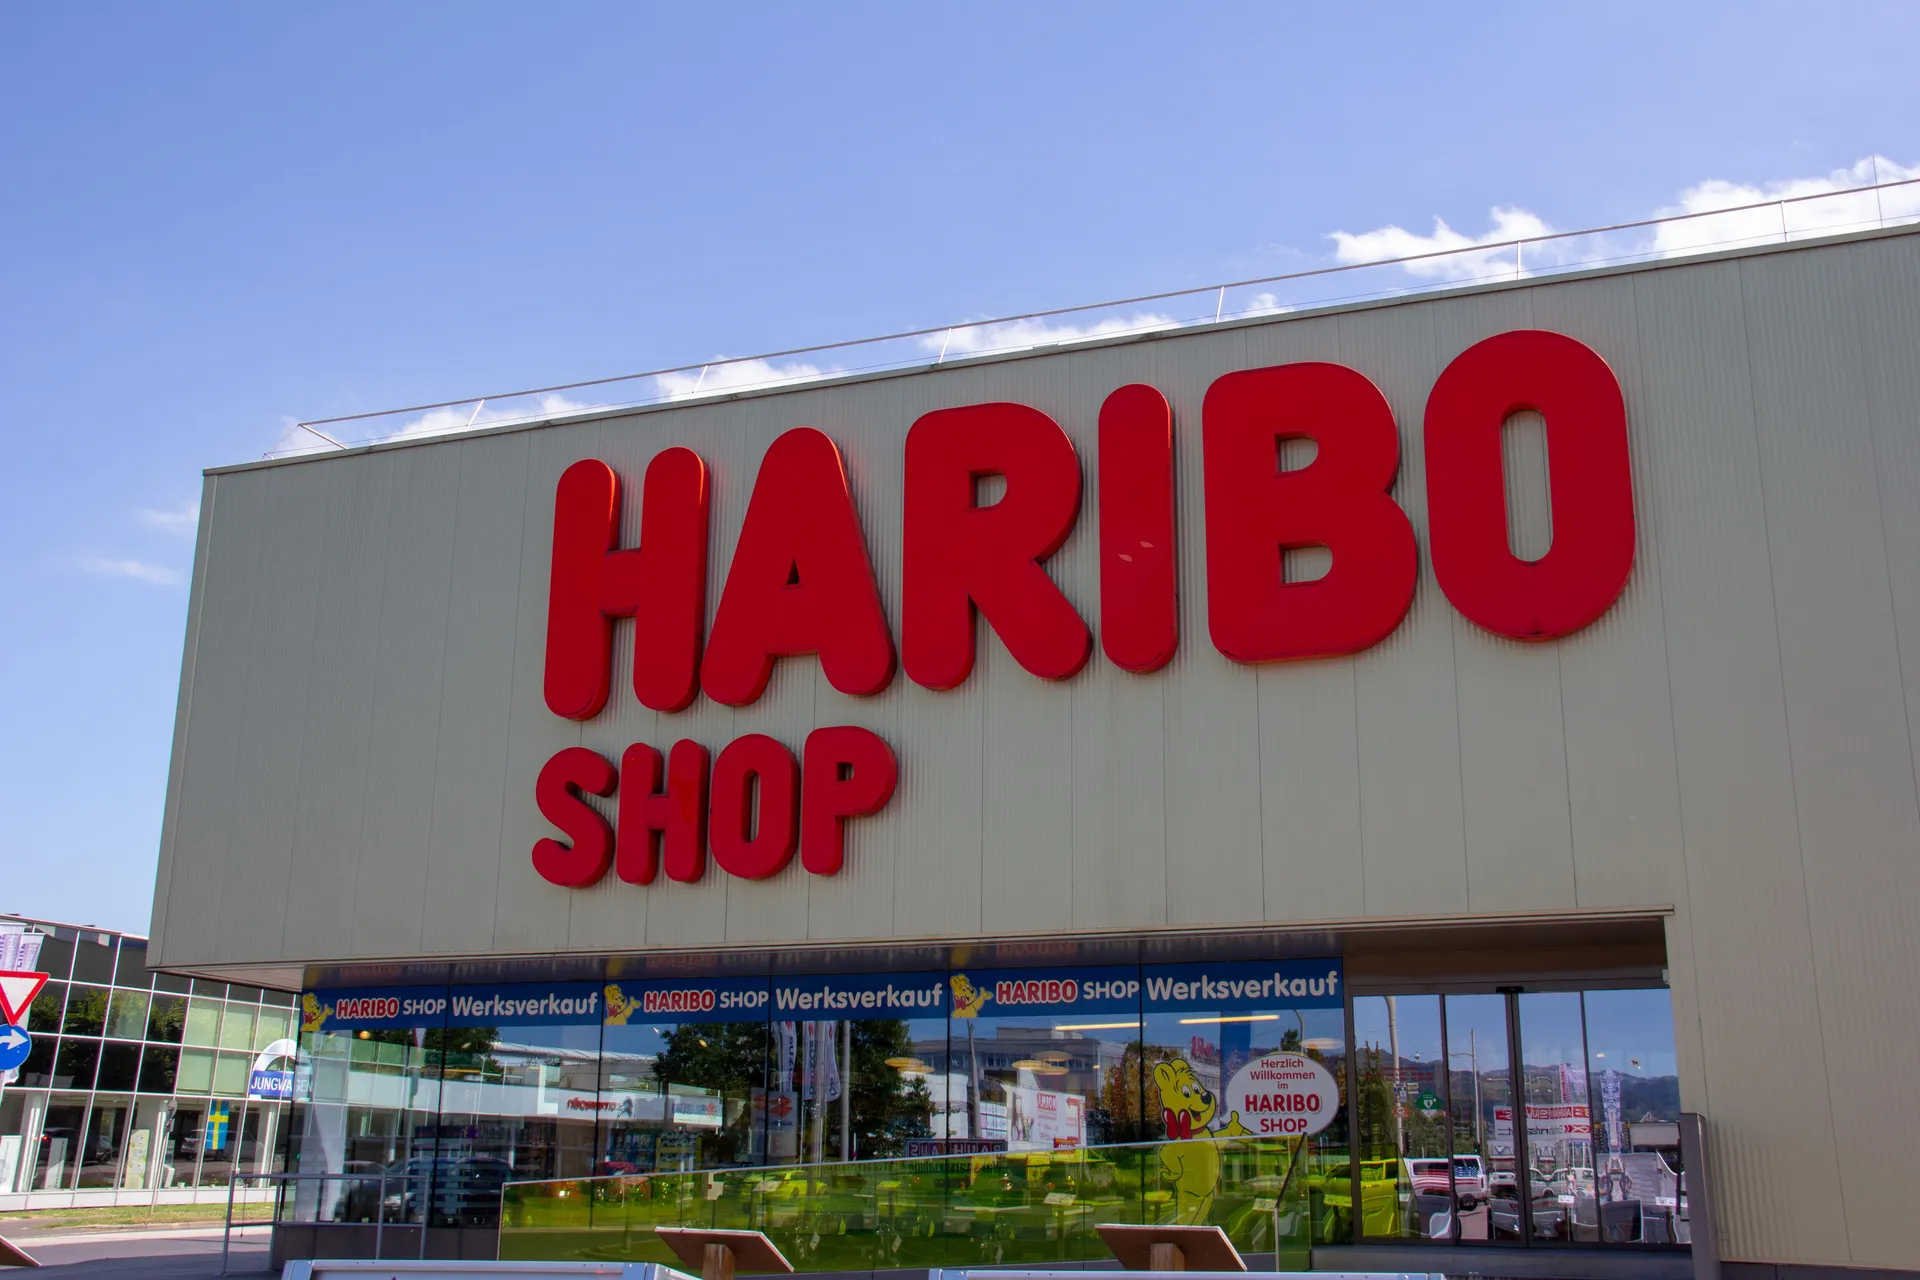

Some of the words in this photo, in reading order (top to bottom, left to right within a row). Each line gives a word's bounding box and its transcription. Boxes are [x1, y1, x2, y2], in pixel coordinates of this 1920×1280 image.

[543, 328, 1637, 720] HARIBO
[531, 725, 900, 889] SHOP
[644, 989, 715, 1012] HARIBO
[720, 991, 769, 1008] SHOP
[776, 983, 943, 1009] Werksverkauf
[996, 978, 1077, 1004] HARIBO
[1083, 981, 1139, 999] SHOP
[1146, 971, 1338, 1001] Werksverkauf
[335, 997, 399, 1020] HARIBO
[402, 998, 447, 1016] SHOP
[452, 992, 598, 1016] Werksverkauf
[1261, 1058, 1304, 1068] Herzlich
[1250, 1071, 1315, 1080] Willkommen
[1277, 1081, 1289, 1089] im
[1244, 1093, 1321, 1113] HARIBO
[1260, 1118, 1308, 1133] SHOP
